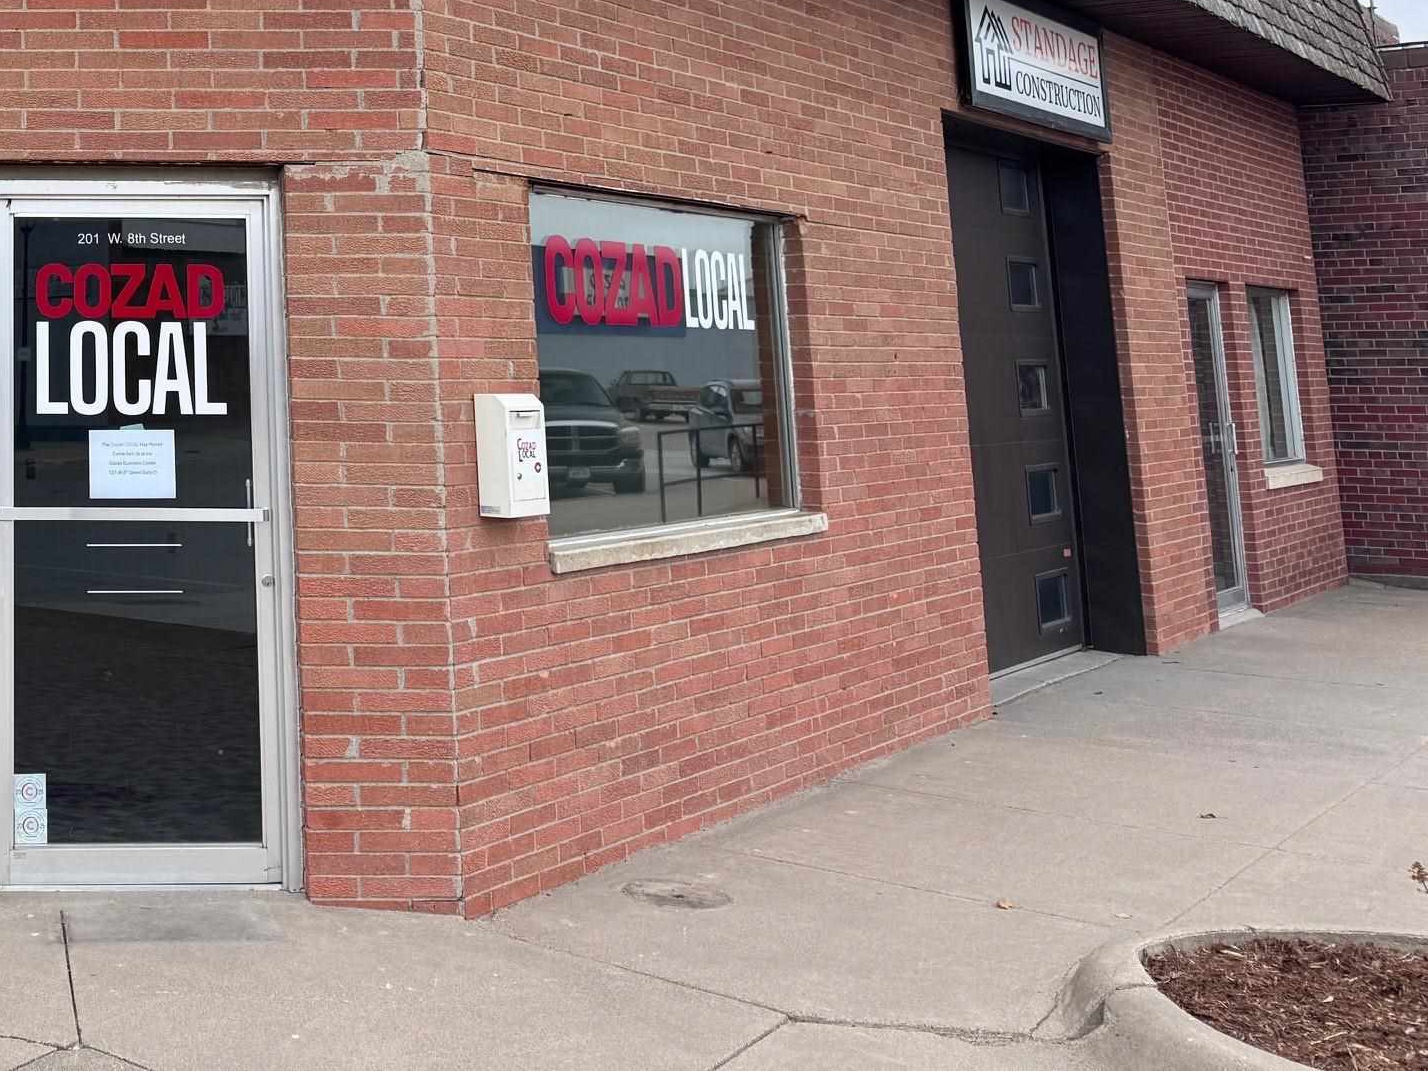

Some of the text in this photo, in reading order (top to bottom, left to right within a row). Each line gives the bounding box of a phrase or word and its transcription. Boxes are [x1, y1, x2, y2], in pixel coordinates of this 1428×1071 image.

[1011, 16, 1098, 79] STANDAGE
[1015, 70, 1102, 118] CONSTRUCTION
[77, 232, 186, 245] 201 W. 8th Street
[35, 263, 226, 319] COZAD
[544, 234, 756, 331] COZAD LOCAL
[35, 320, 228, 416] LOCAL
